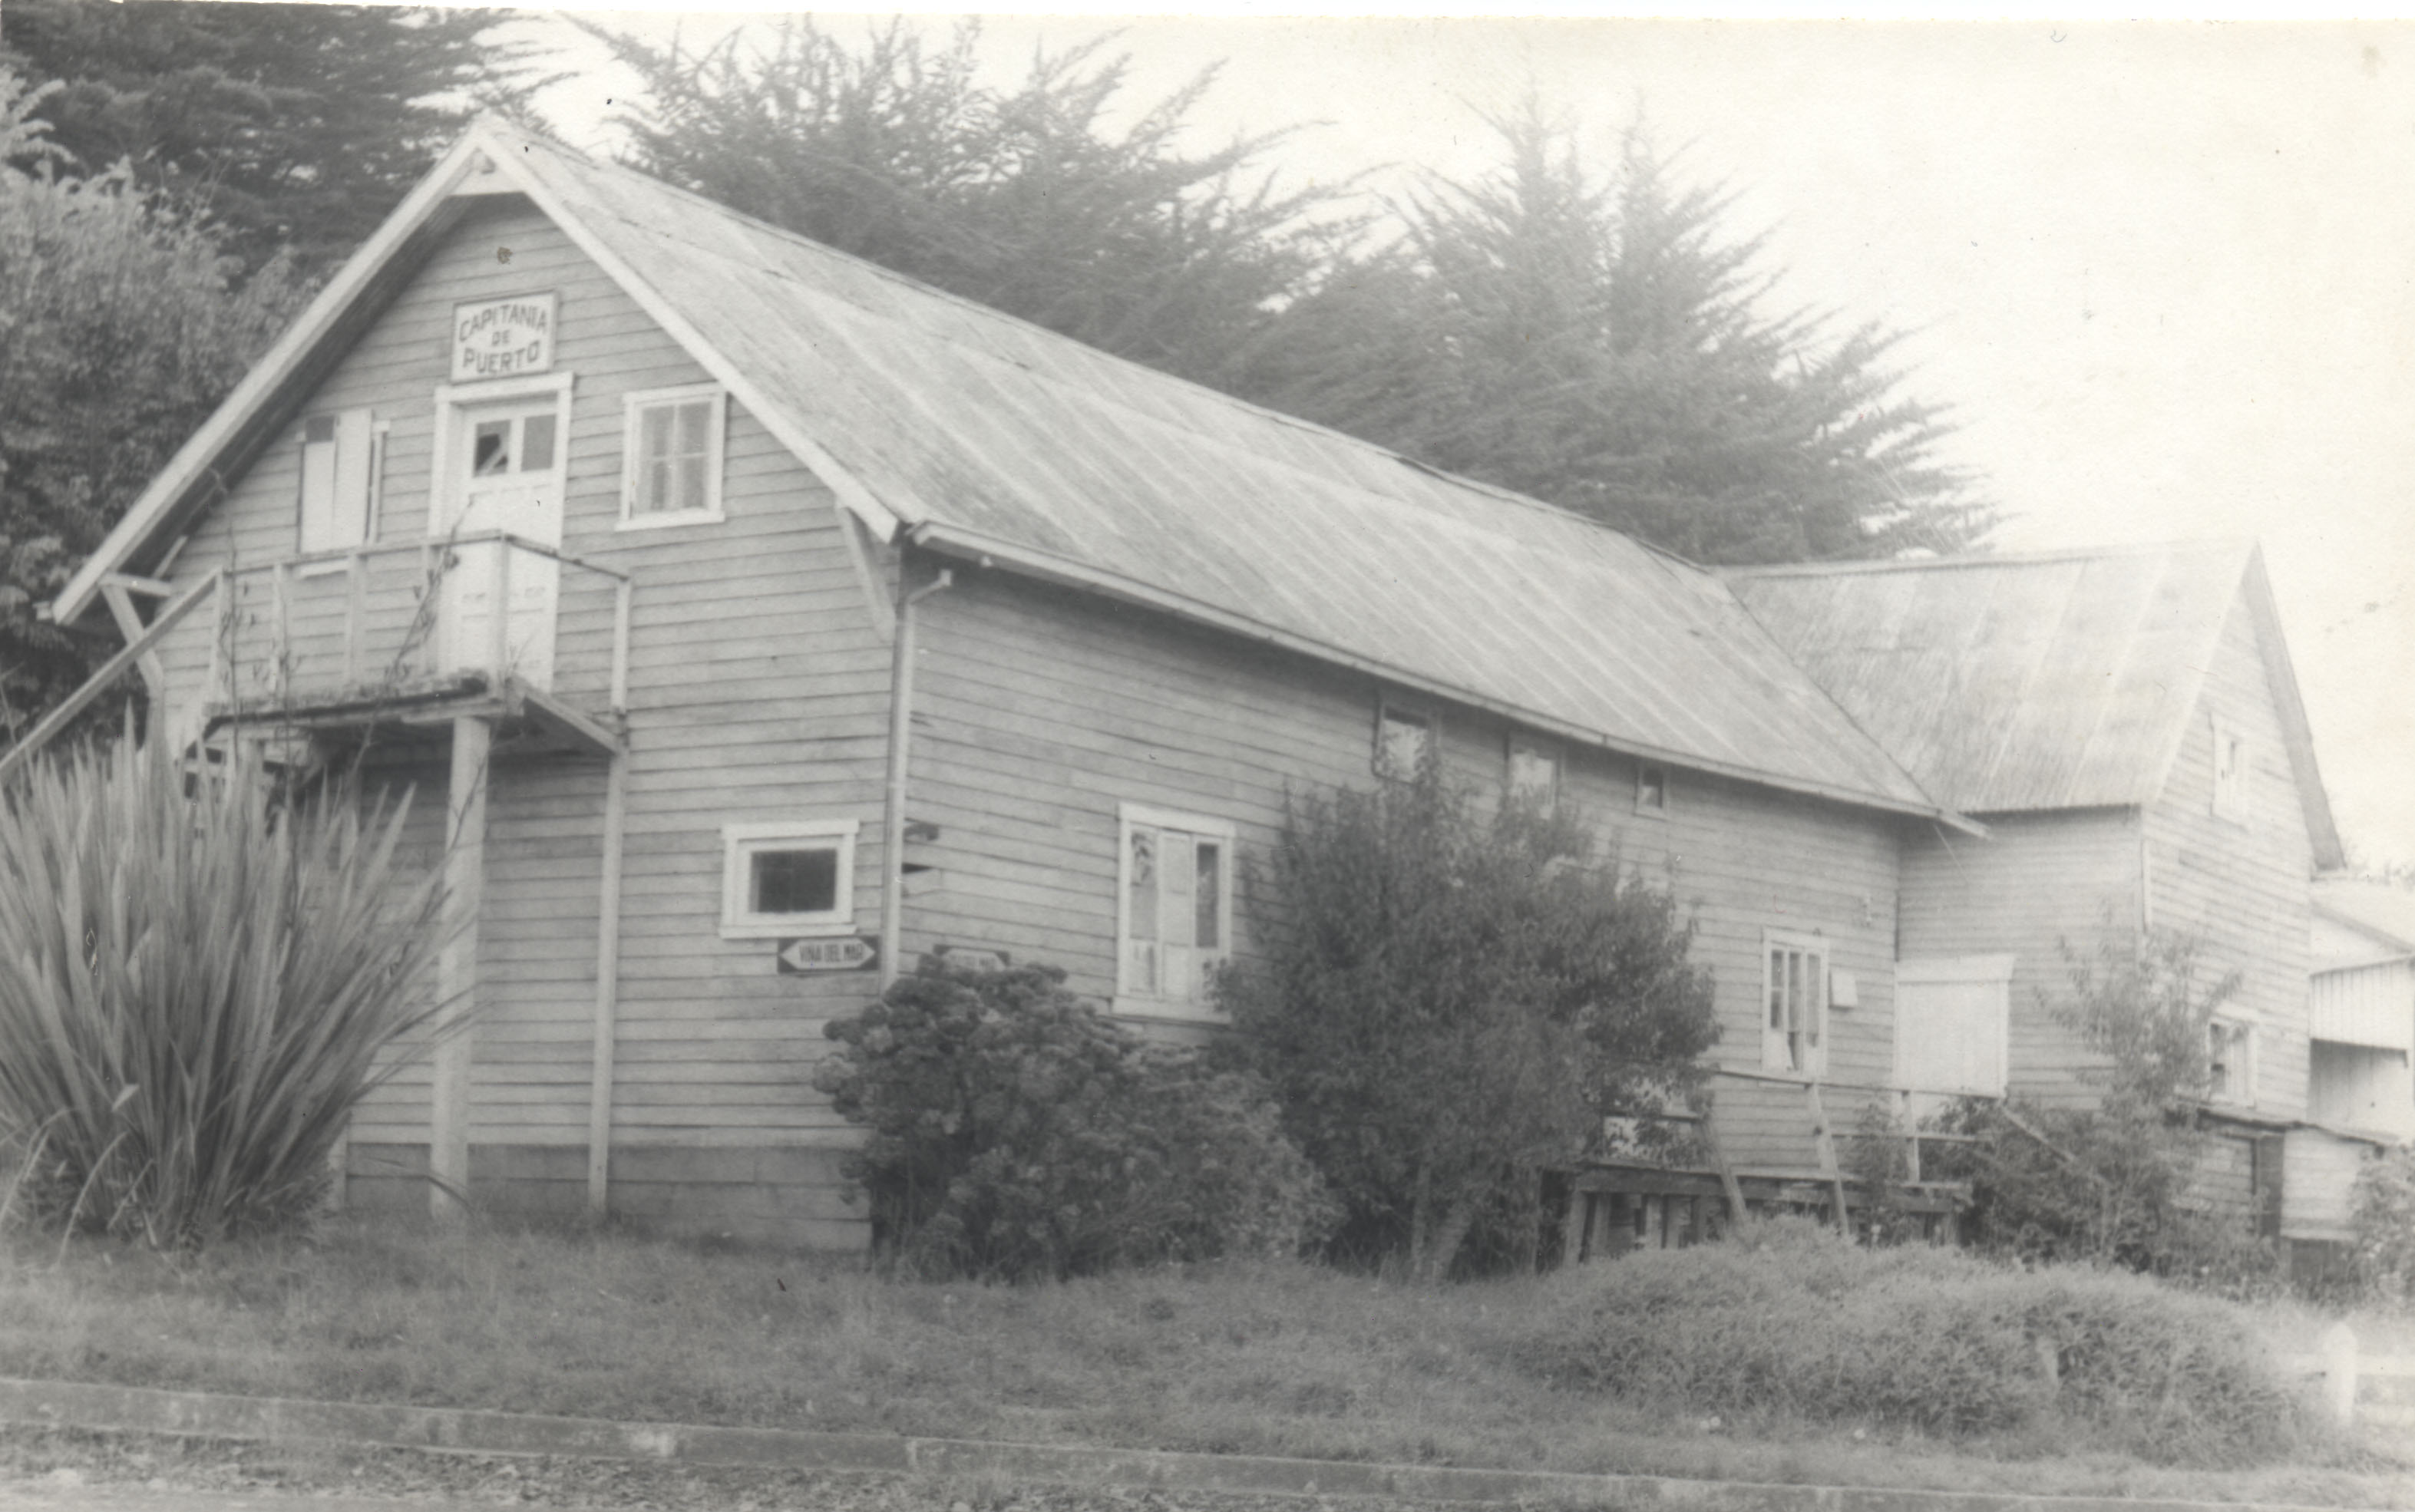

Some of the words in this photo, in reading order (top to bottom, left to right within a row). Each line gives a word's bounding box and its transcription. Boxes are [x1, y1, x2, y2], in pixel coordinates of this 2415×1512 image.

[459, 304, 547, 342] CAPITANIA
[491, 330, 510, 347] DE
[462, 339, 540, 373] PUERTO
[824, 943, 841, 962] DEL
[844, 943, 864, 961] MAR
